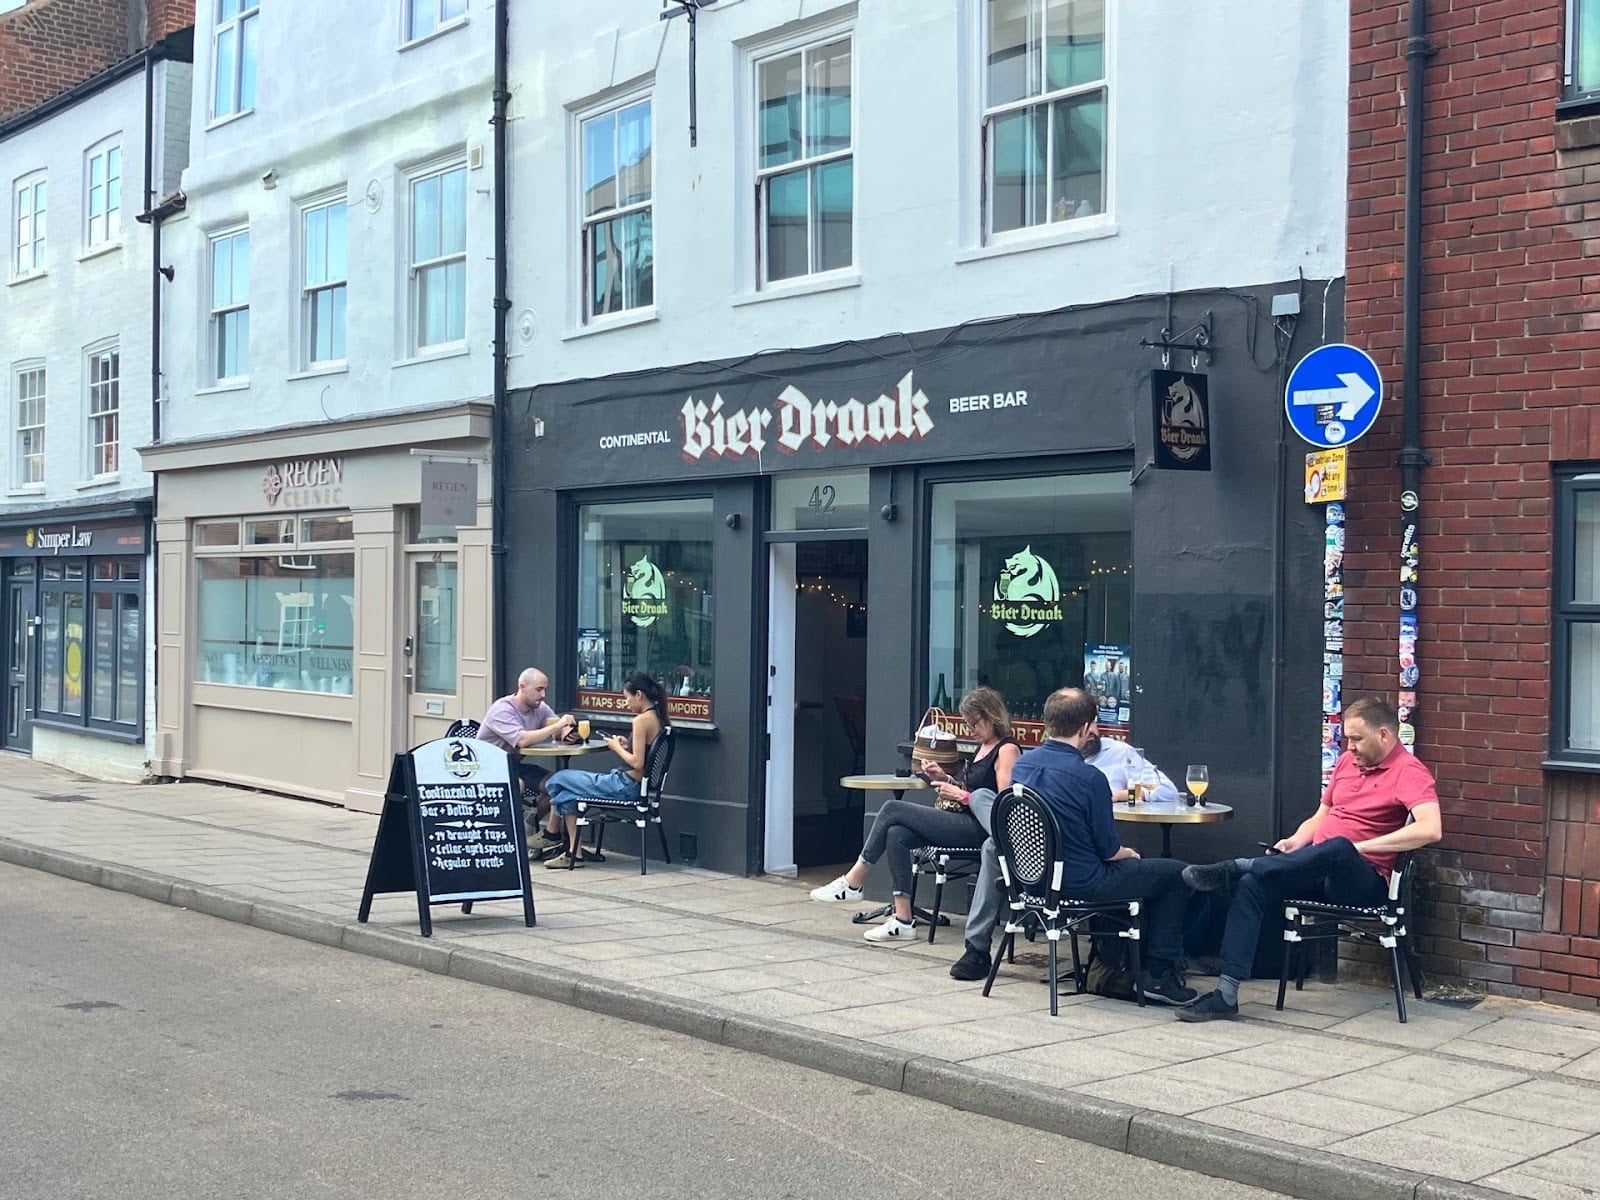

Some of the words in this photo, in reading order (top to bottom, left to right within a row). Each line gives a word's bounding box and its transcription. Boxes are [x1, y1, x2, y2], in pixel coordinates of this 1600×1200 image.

[949, 394, 990, 413] BEER
[993, 390, 1028, 407] BAR
[680, 391, 772, 463] Bier
[777, 370, 935, 452] Draak
[599, 430, 671, 449] CONTINENTAL
[1161, 427, 1180, 443] Bier
[1180, 428, 1207, 445] Draak
[284, 459, 342, 487] REGEN
[432, 481, 468, 493] REGEN
[284, 488, 342, 507] CLINIC
[808, 485, 836, 515] 42
[71, 525, 93, 547] Law
[622, 601, 640, 615] Bier
[641, 600, 668, 615] Draak
[991, 603, 1019, 621] Bier
[1020, 603, 1063, 621] Draak
[591, 696, 613, 708] TAPS
[667, 702, 710, 716] IMPORTS
[937, 721, 974, 737] DRIN
[417, 784, 477, 800] Continental
[477, 783, 504, 798] Beer
[420, 806, 439, 817] Bar
[447, 804, 474, 816] Bottle
[475, 803, 501, 818] Shop
[435, 856, 472, 870] Regular
[474, 856, 504, 868] events
